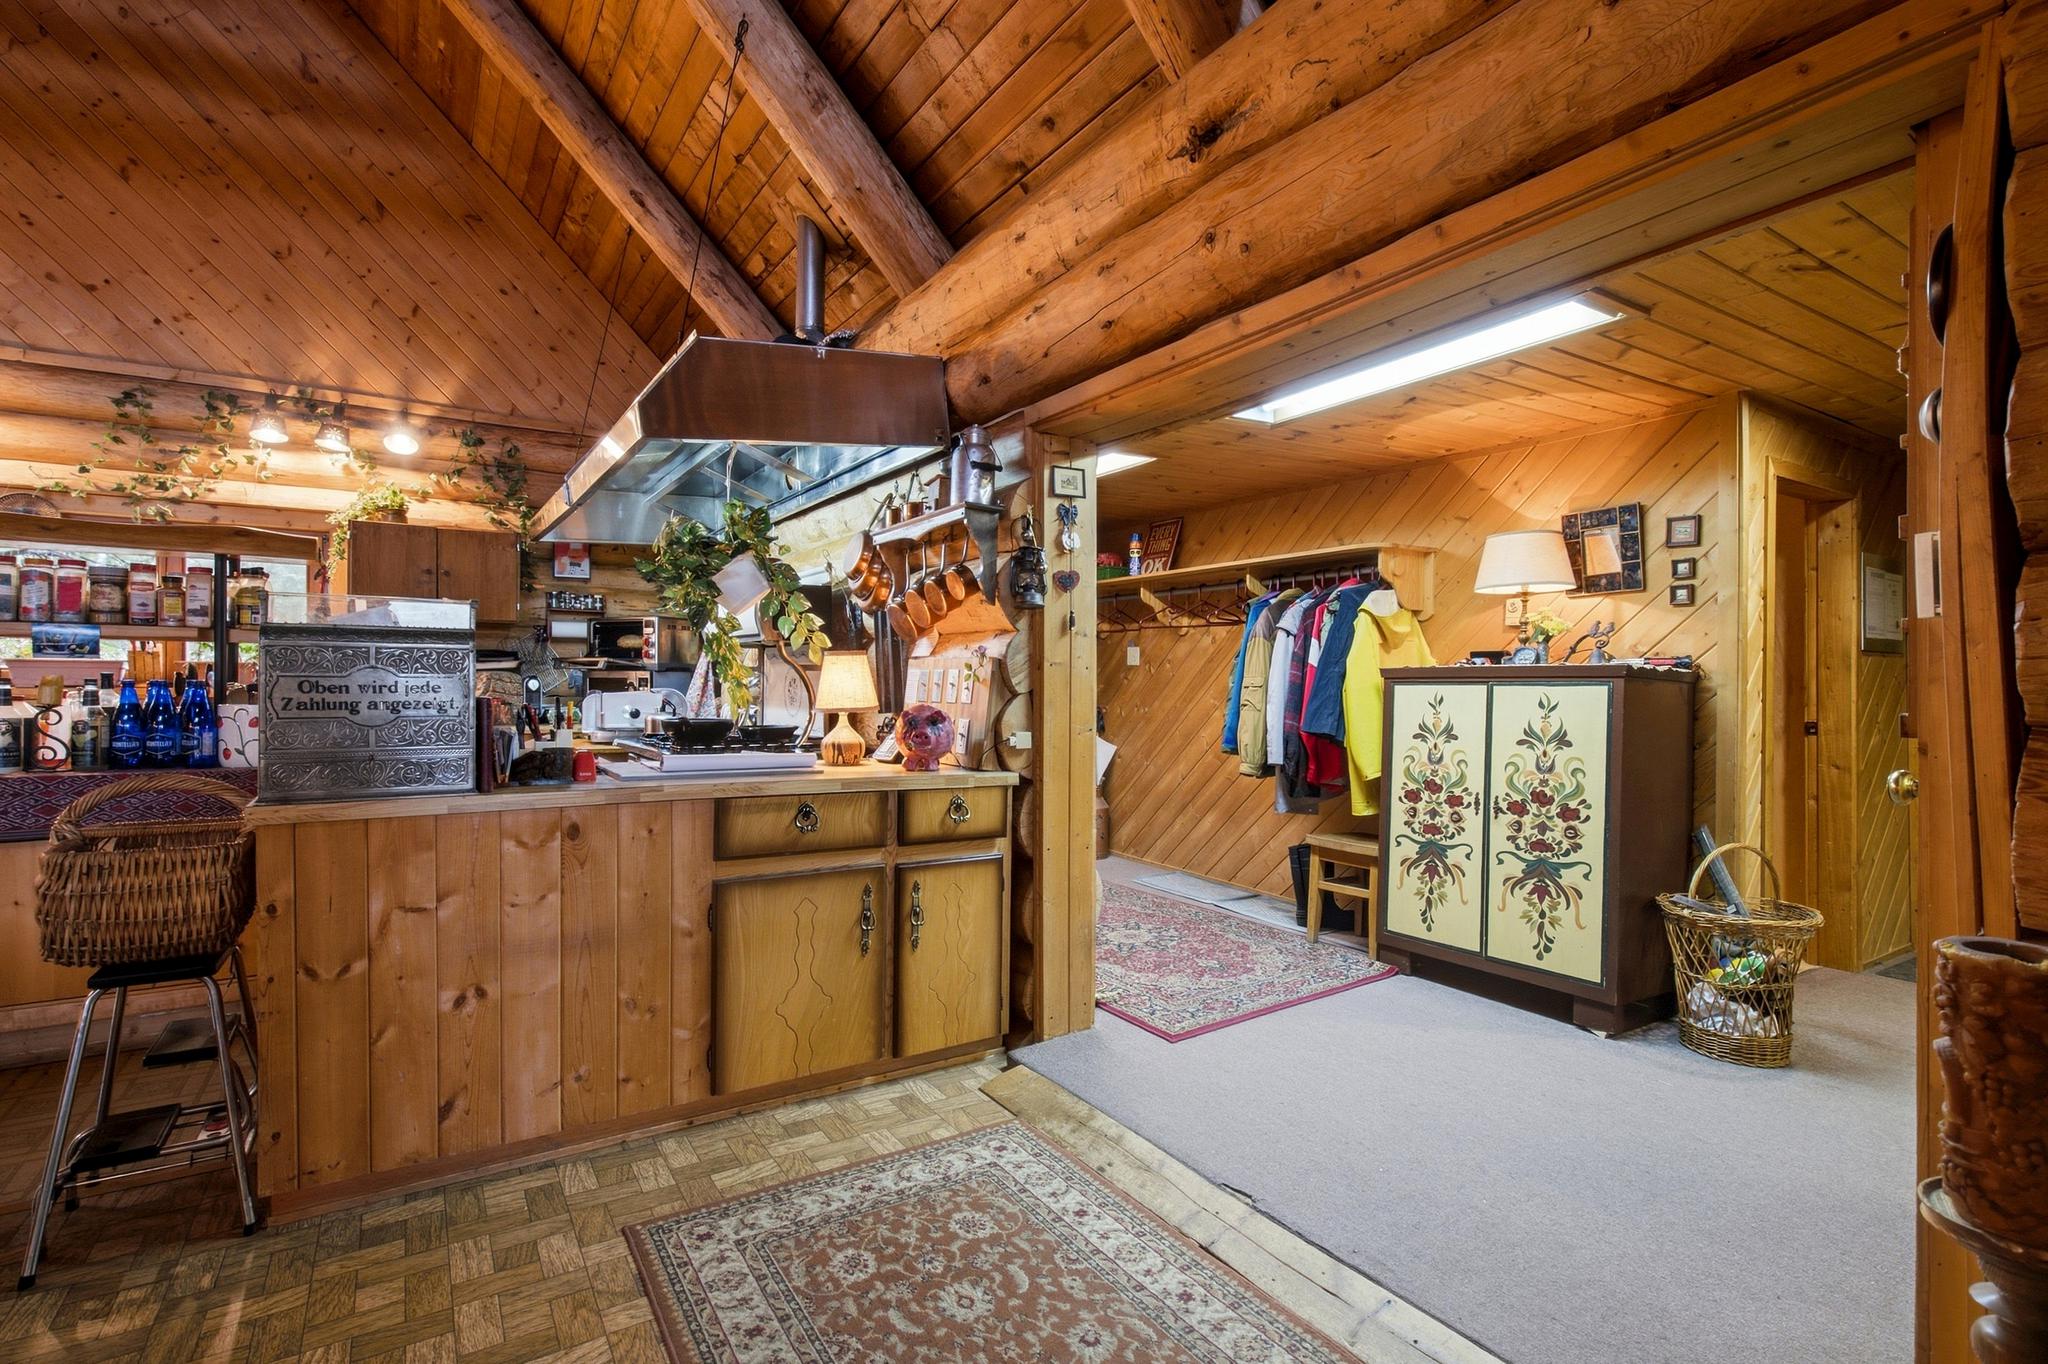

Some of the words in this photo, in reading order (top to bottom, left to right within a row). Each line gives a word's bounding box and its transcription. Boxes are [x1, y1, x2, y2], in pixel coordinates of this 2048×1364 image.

[1151, 524, 1176, 540] EVERY
[1147, 539, 1171, 554] THING
[1141, 557, 1167, 575] OK
[297, 679, 350, 694] Oben
[357, 680, 399, 694] wird
[404, 680, 442, 697] jede
[280, 697, 361, 715] Zahlung
[366, 696, 460, 714] angezeigt.
